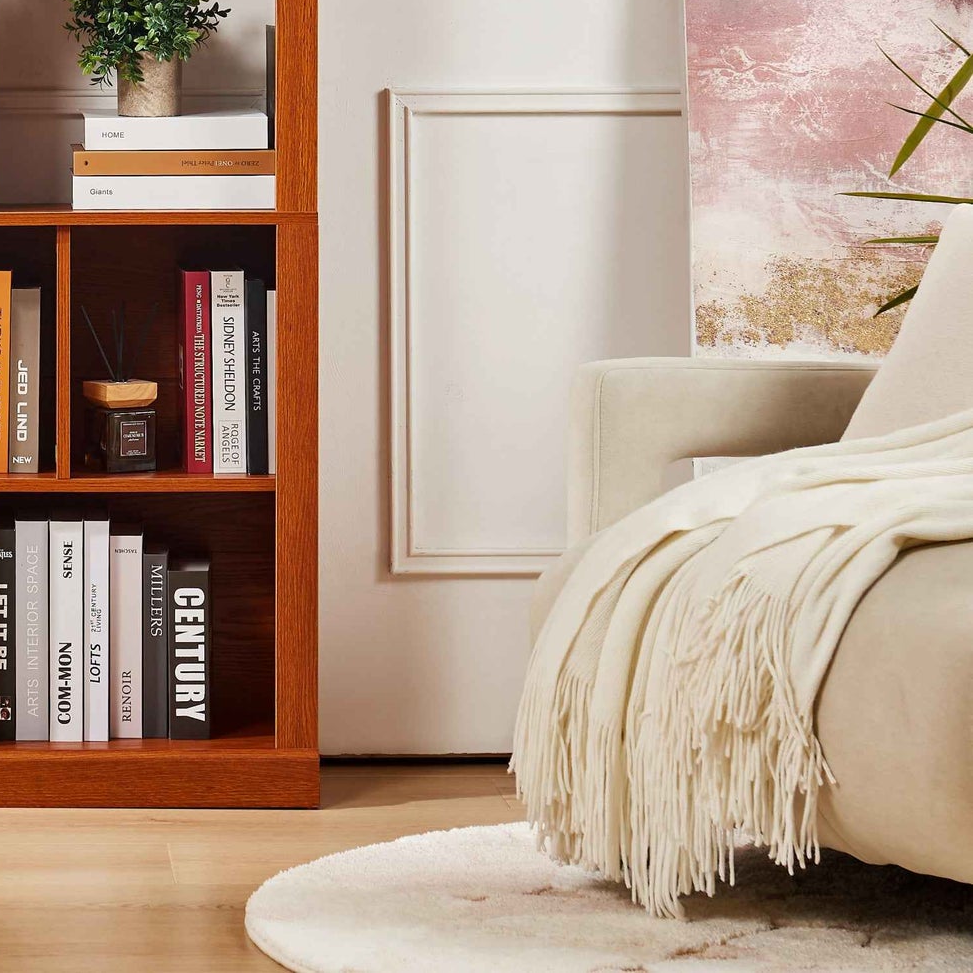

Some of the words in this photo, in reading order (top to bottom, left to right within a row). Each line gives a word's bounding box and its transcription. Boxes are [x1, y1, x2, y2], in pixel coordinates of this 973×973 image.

[90, 188, 113, 196] Giants
[193, 334, 205, 351] THE
[223, 316, 235, 355] SIDNEY
[252, 331, 261, 353] ARTS
[17, 359, 28, 394] JED
[193, 352, 205, 405] STRUCTURED
[223, 358, 236, 411] SHELDON
[252, 356, 260, 375] THE
[252, 378, 261, 411] CRAFTS
[16, 402, 28, 442] LIND
[194, 406, 205, 428] NOTE
[12, 456, 33, 464] NEW
[221, 425, 230, 463] ANGELS
[231, 452, 239, 465] OF
[26, 545, 39, 594] SPACE
[63, 540, 73, 579] SENSE
[150, 564, 163, 637] MILLERS
[26, 601, 39, 670] INTERIOR
[174, 587, 206, 722] CENTURY
[90, 643, 102, 684] LOFTS
[27, 679, 39, 717] ARTS
[57, 642, 72, 725] COM-MON
[121, 670, 132, 722] RENOIR
